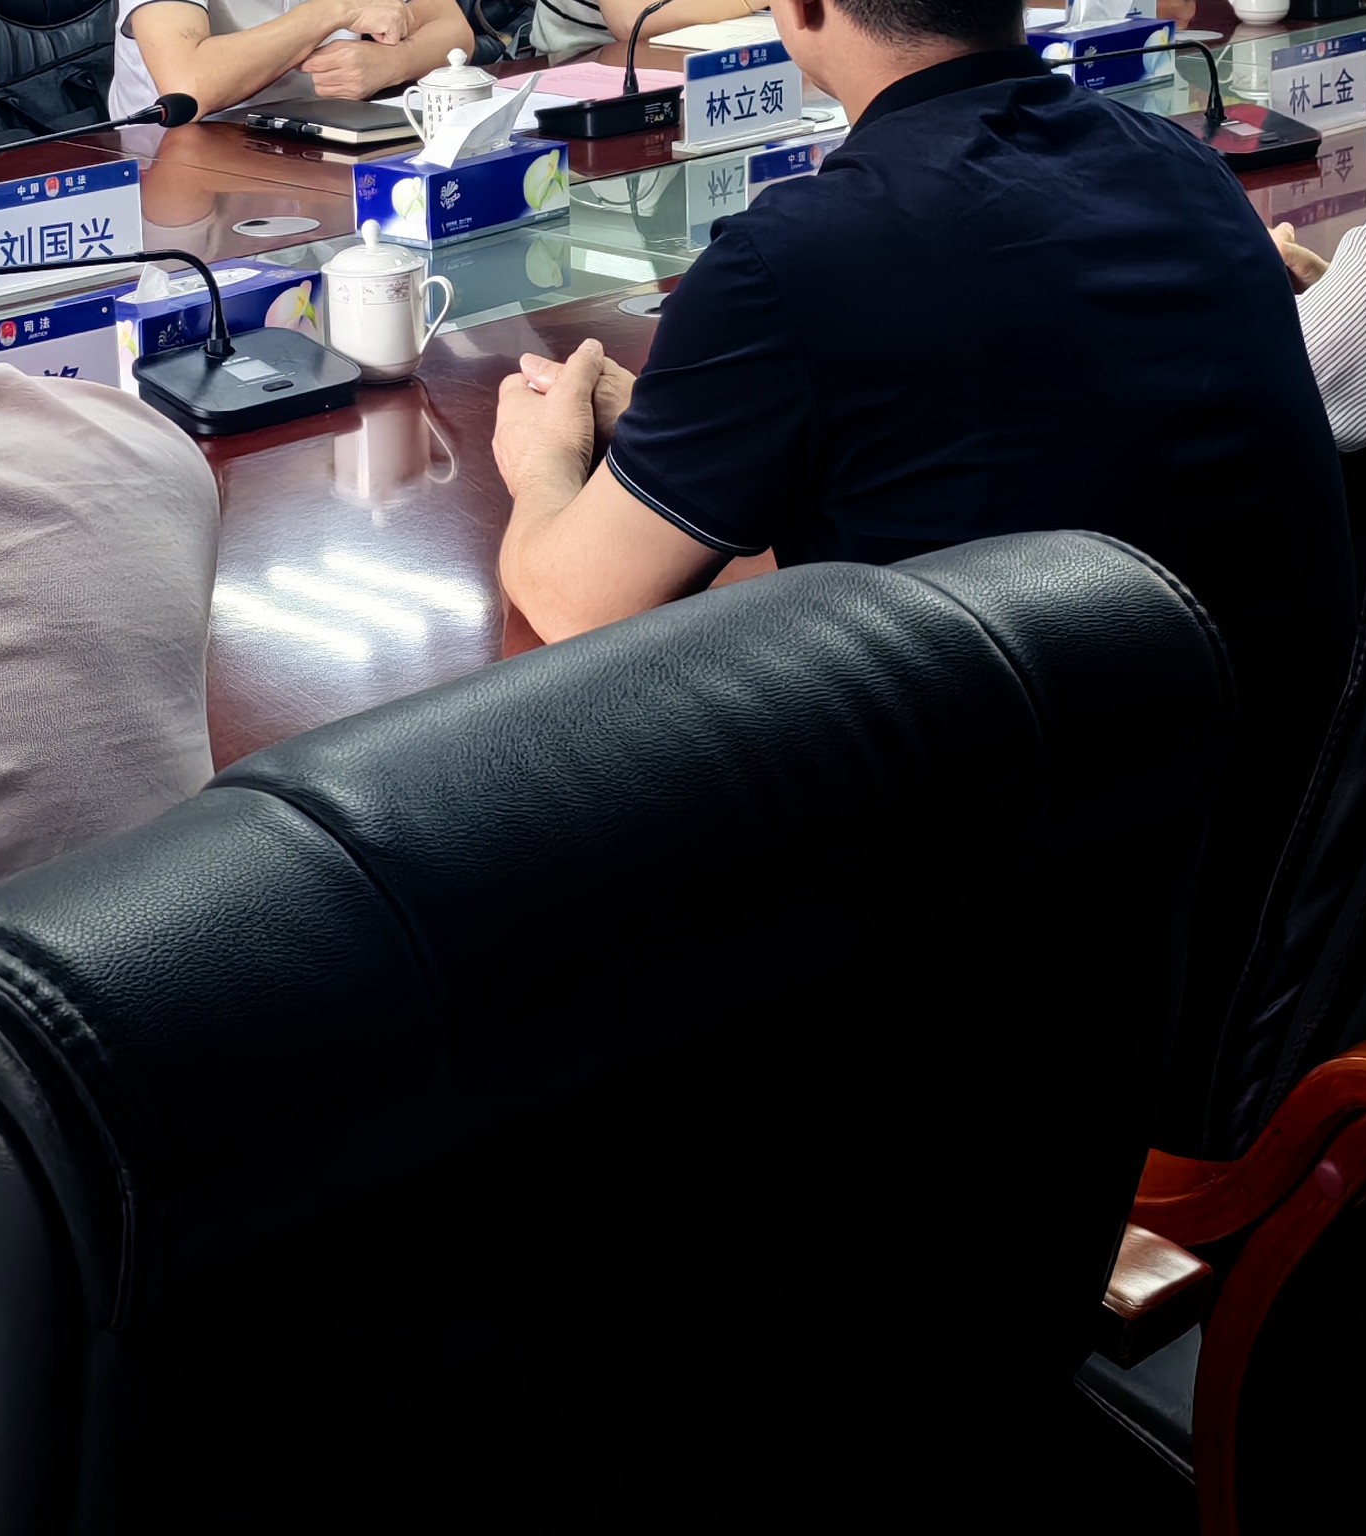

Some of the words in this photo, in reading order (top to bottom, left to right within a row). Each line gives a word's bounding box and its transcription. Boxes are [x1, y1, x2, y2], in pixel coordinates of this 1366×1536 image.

[706, 79, 784, 128] 林立领
[1289, 68, 1355, 115] 林上金
[17, 182, 40, 196] 中国
[65, 175, 87, 187] 司法
[23, 317, 50, 333] 司法
